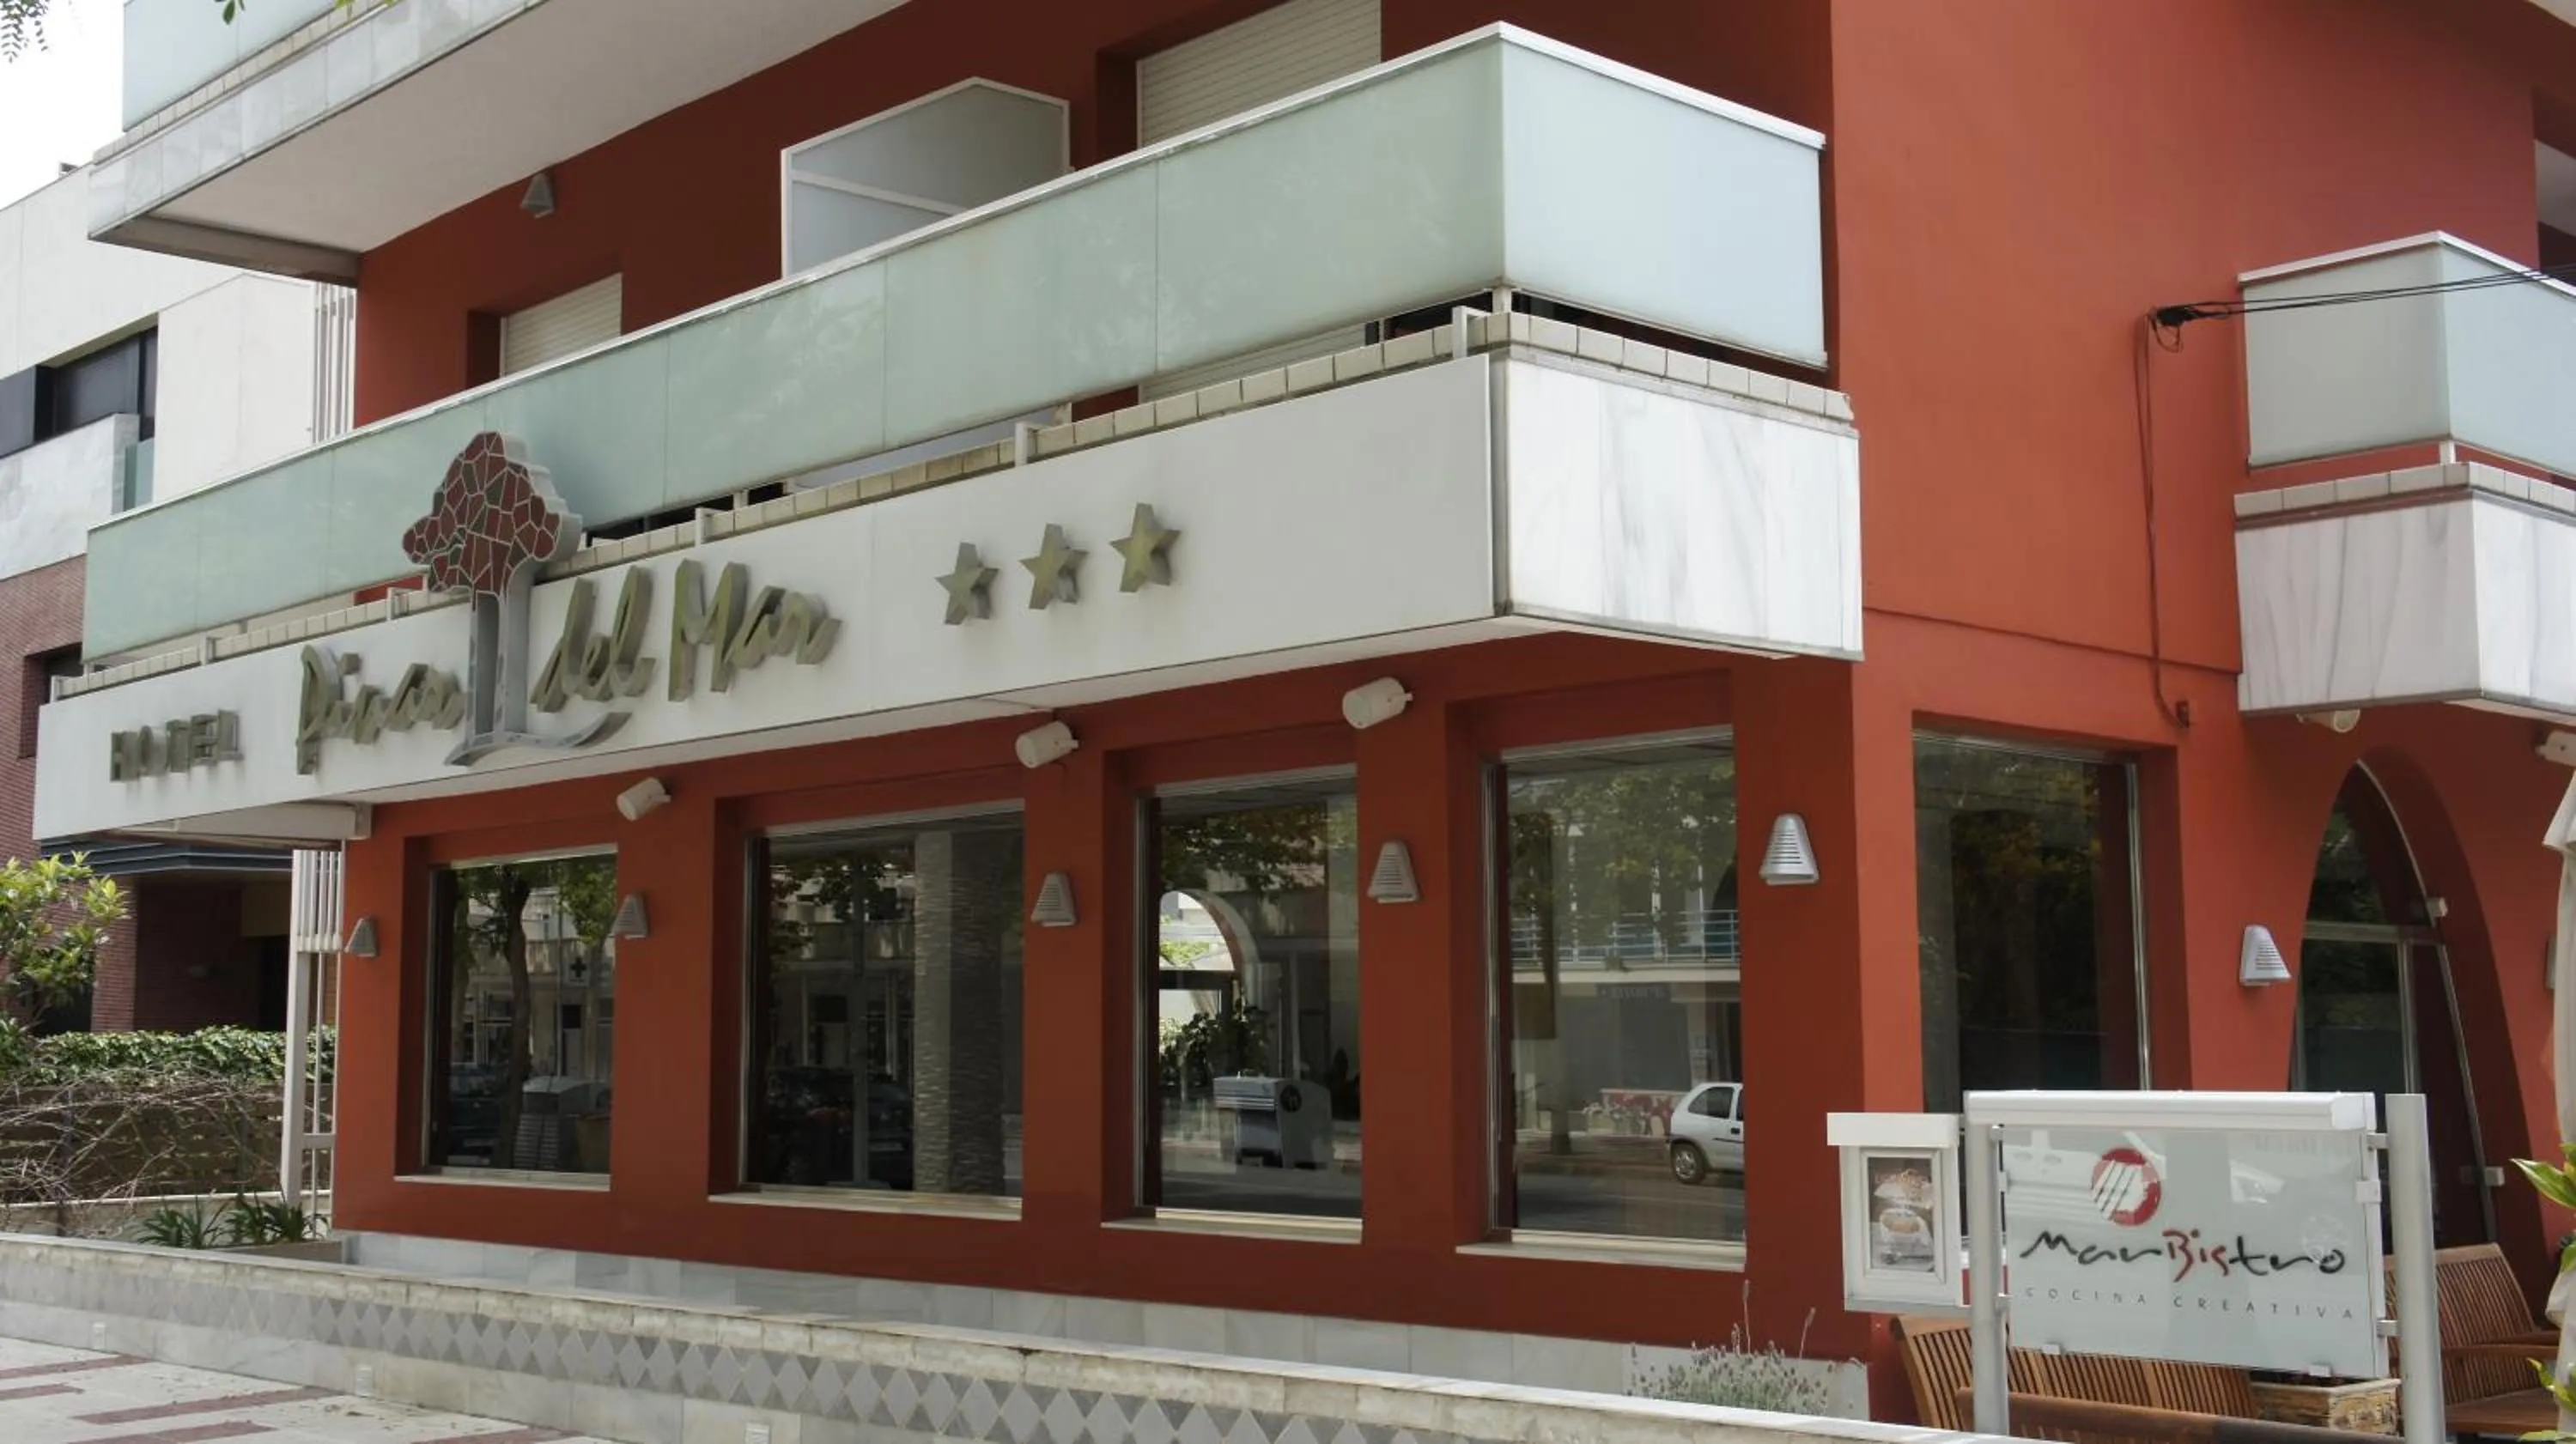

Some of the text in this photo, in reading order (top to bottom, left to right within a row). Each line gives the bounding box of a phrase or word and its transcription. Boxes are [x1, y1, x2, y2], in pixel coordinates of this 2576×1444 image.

[110, 709, 245, 783] HOTEL
[529, 577, 656, 713] del
[668, 558, 842, 702] Mar
[2025, 1288, 2354, 1320] COCINA CREATIVA
